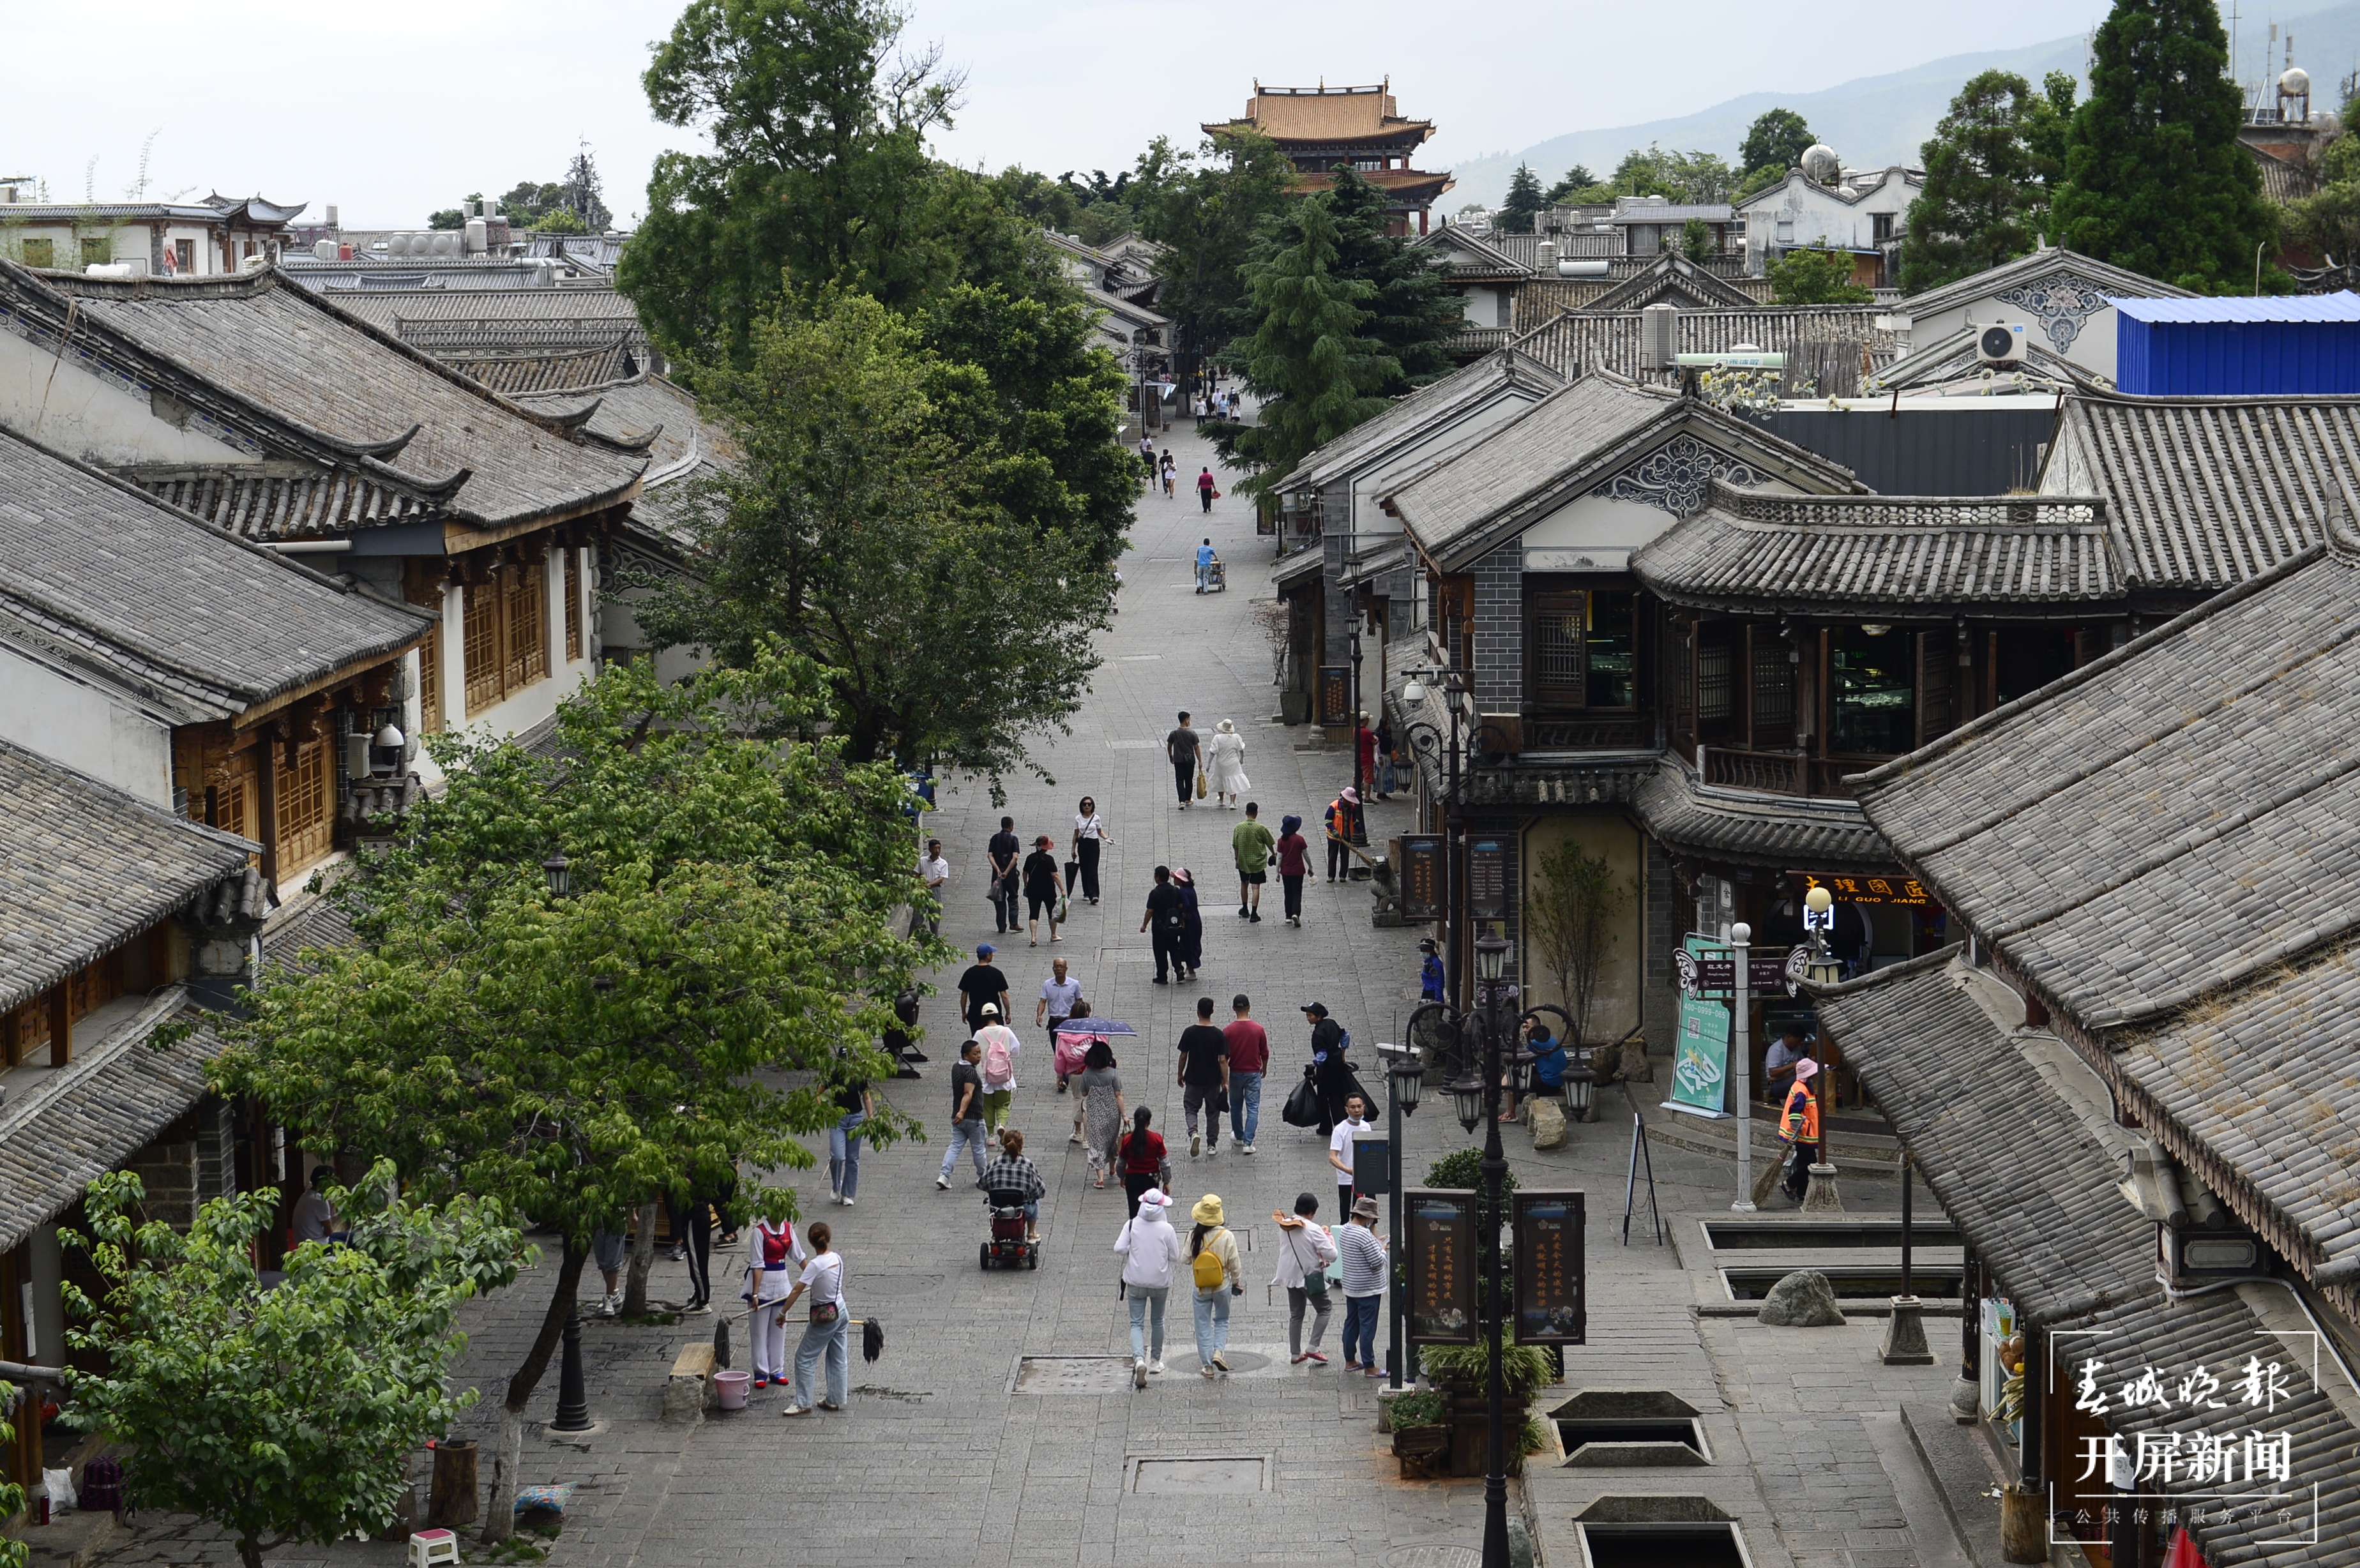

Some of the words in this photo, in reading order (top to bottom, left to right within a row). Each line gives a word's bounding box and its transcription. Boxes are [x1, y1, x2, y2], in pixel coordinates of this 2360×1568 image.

[1684, 1003, 1726, 1019] 400-0999-065
[1426, 1244, 1439, 1308] 才有文明的城市
[1442, 1236, 1454, 1300] 只有文明的市民
